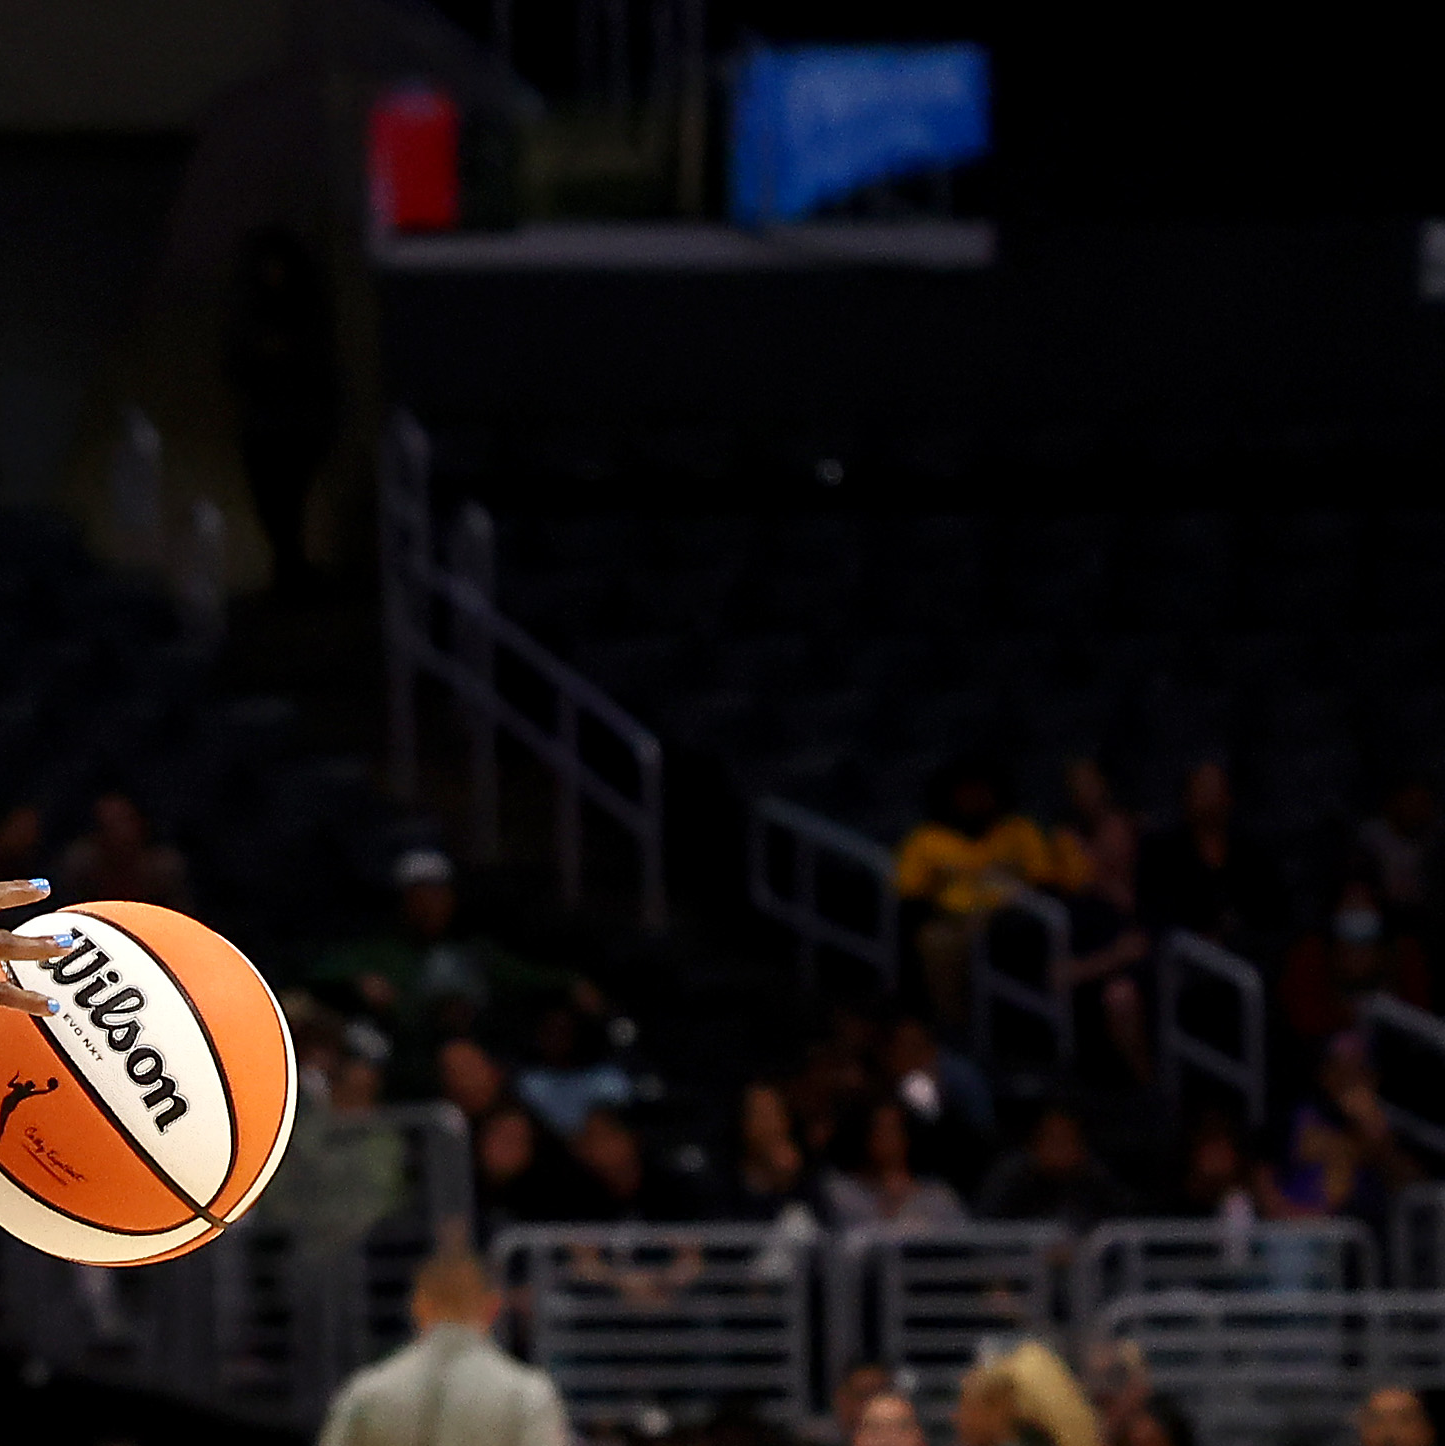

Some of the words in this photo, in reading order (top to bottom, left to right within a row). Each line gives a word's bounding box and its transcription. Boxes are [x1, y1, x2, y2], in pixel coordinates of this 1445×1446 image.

[37, 926, 190, 1135] Wilson
[62, 1013, 83, 1037] EVO
[83, 1038, 103, 1061] NXT
